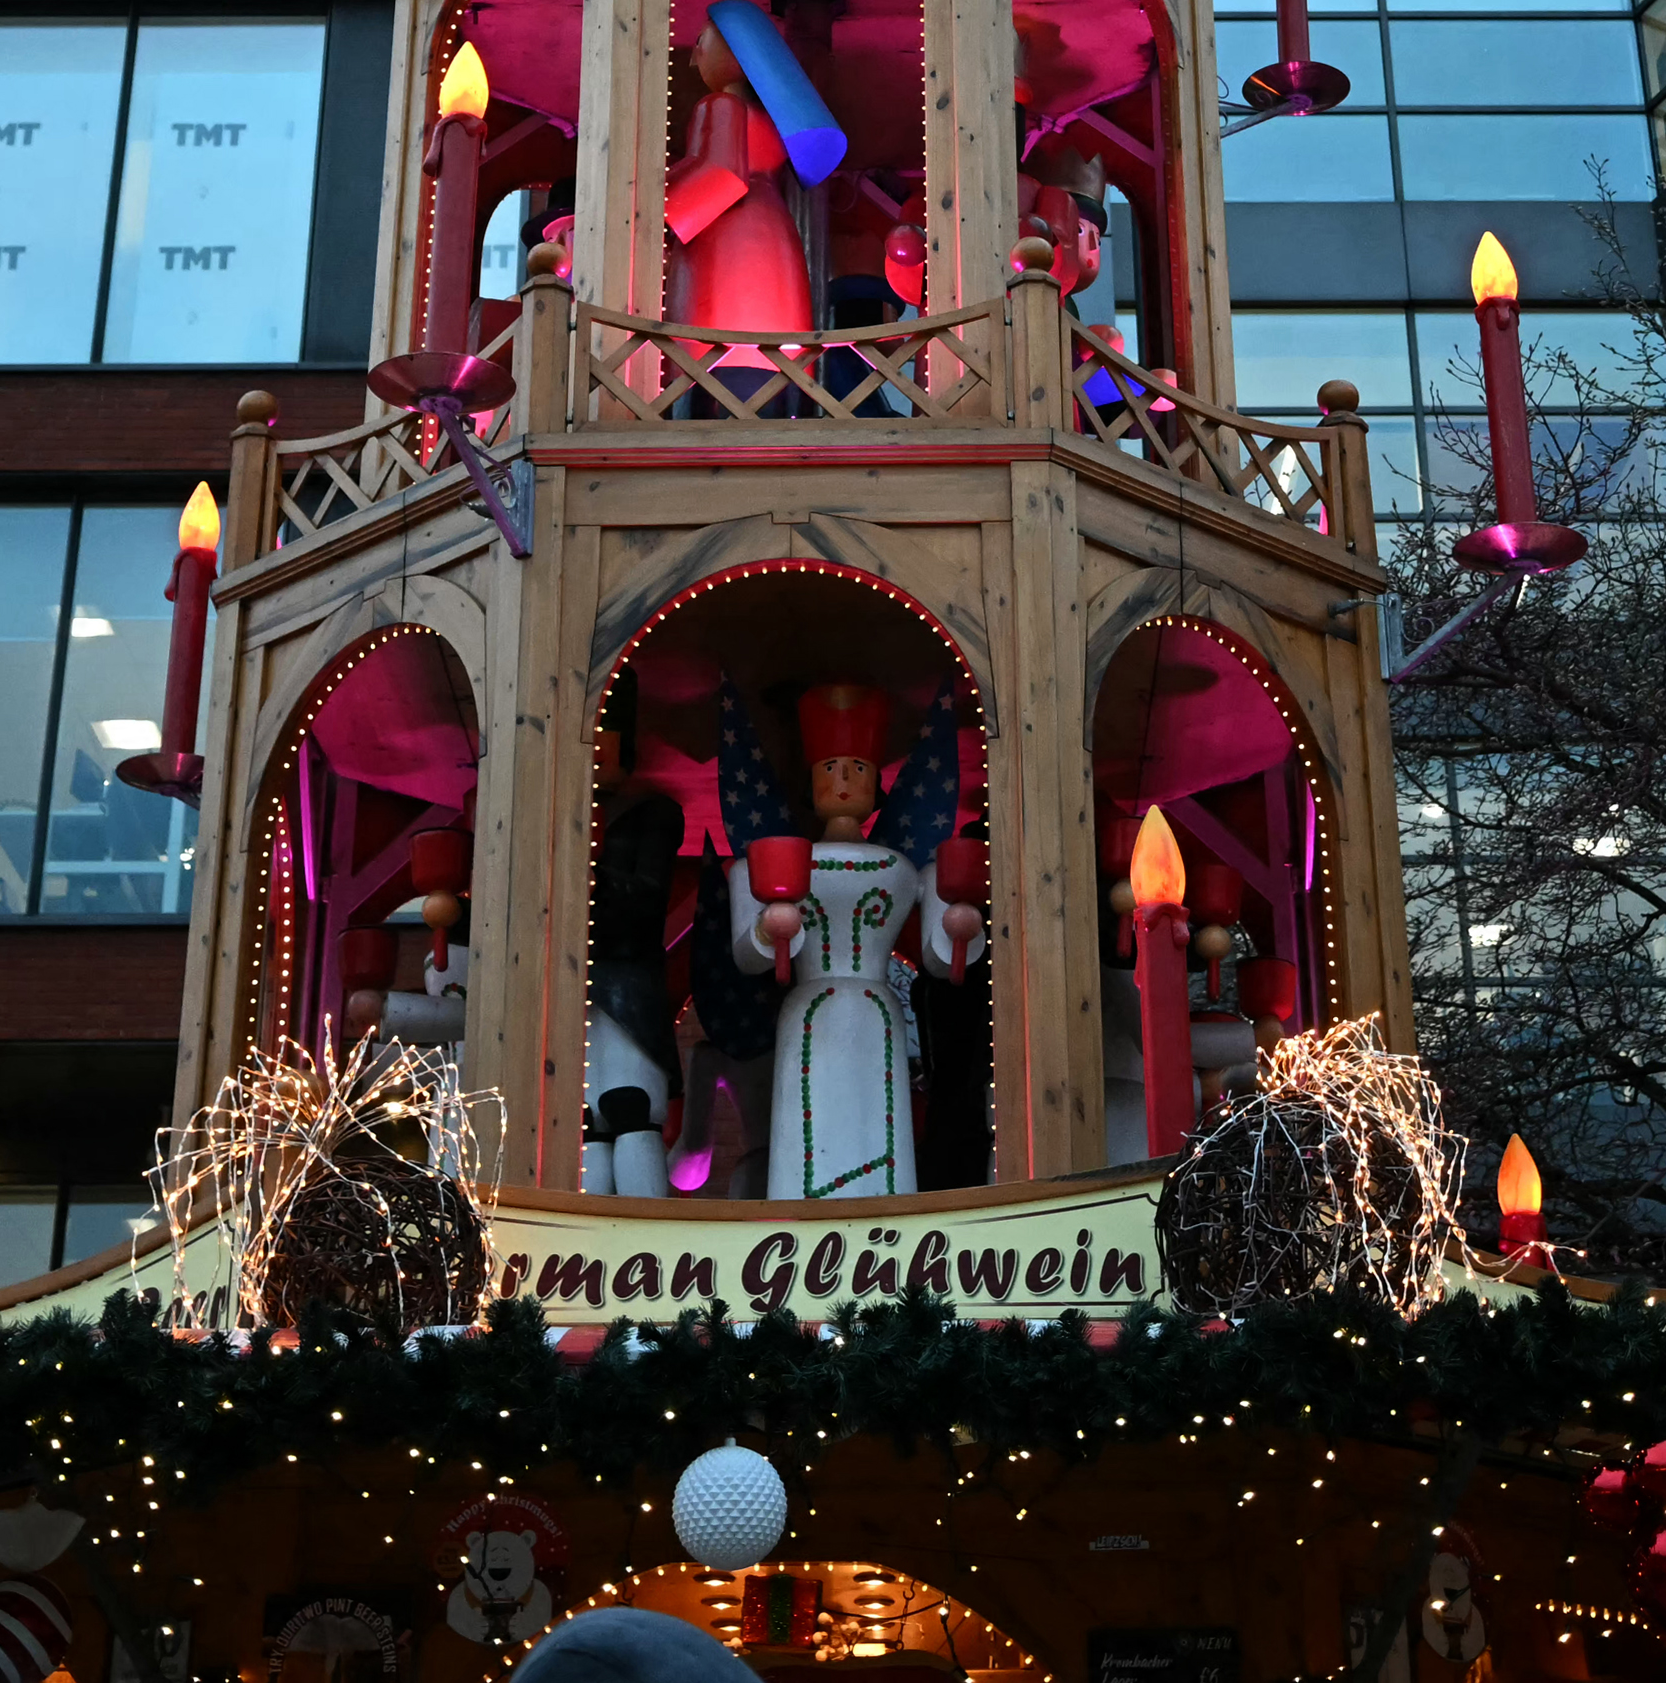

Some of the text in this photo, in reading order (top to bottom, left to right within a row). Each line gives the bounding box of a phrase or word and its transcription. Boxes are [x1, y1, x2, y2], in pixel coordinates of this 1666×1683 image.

[171, 122, 247, 147] TMT
[159, 245, 236, 271] TMT
[500, 1226, 1145, 1314] rman Glühwein
[445, 1499, 486, 1533] Happy
[269, 1649, 284, 1675] TRY
[325, 1597, 354, 1614] PINT
[353, 1602, 383, 1631] BEER
[377, 1627, 397, 1674] STEINS
